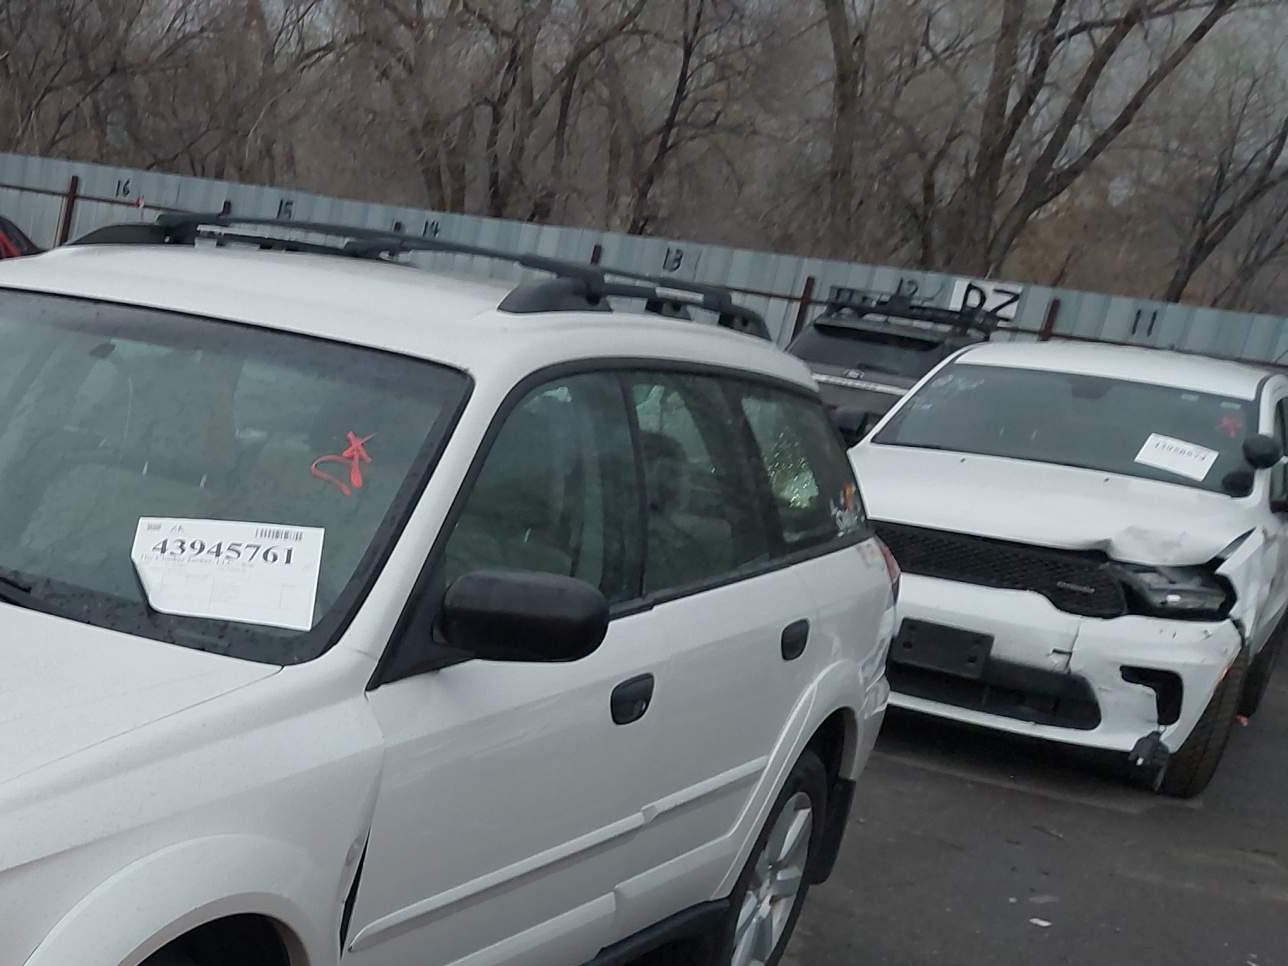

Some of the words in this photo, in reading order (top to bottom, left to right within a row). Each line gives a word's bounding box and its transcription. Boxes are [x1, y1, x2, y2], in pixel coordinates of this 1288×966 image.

[115, 179, 131, 198] 16
[276, 199, 294, 220] 15
[422, 220, 441, 238] 14
[663, 247, 684, 273] 13
[1131, 308, 1158, 337] 11
[152, 537, 295, 566] 43945761
